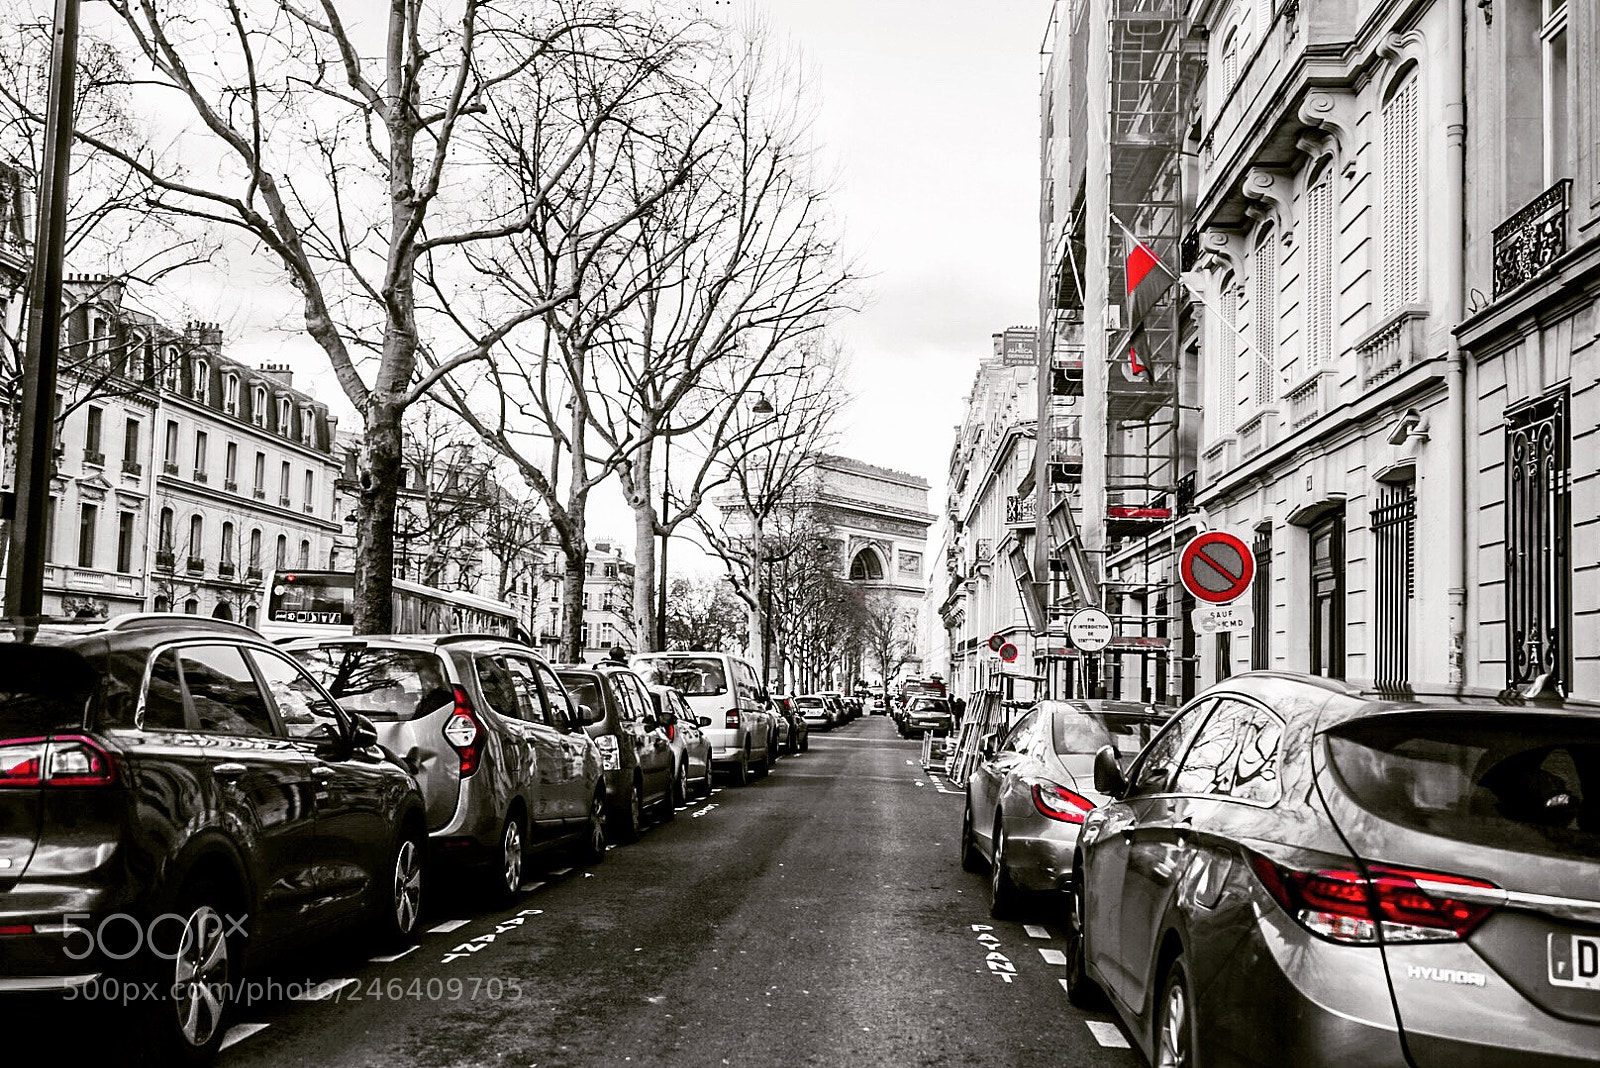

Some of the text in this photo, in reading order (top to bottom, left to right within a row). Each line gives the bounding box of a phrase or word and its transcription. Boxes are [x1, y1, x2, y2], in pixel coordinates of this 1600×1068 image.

[1210, 610, 1232, 619] SAUF
[440, 909, 544, 963] PAYANT
[971, 924, 1018, 983] PAYANT
[1407, 965, 1486, 987] HYUNDAI
